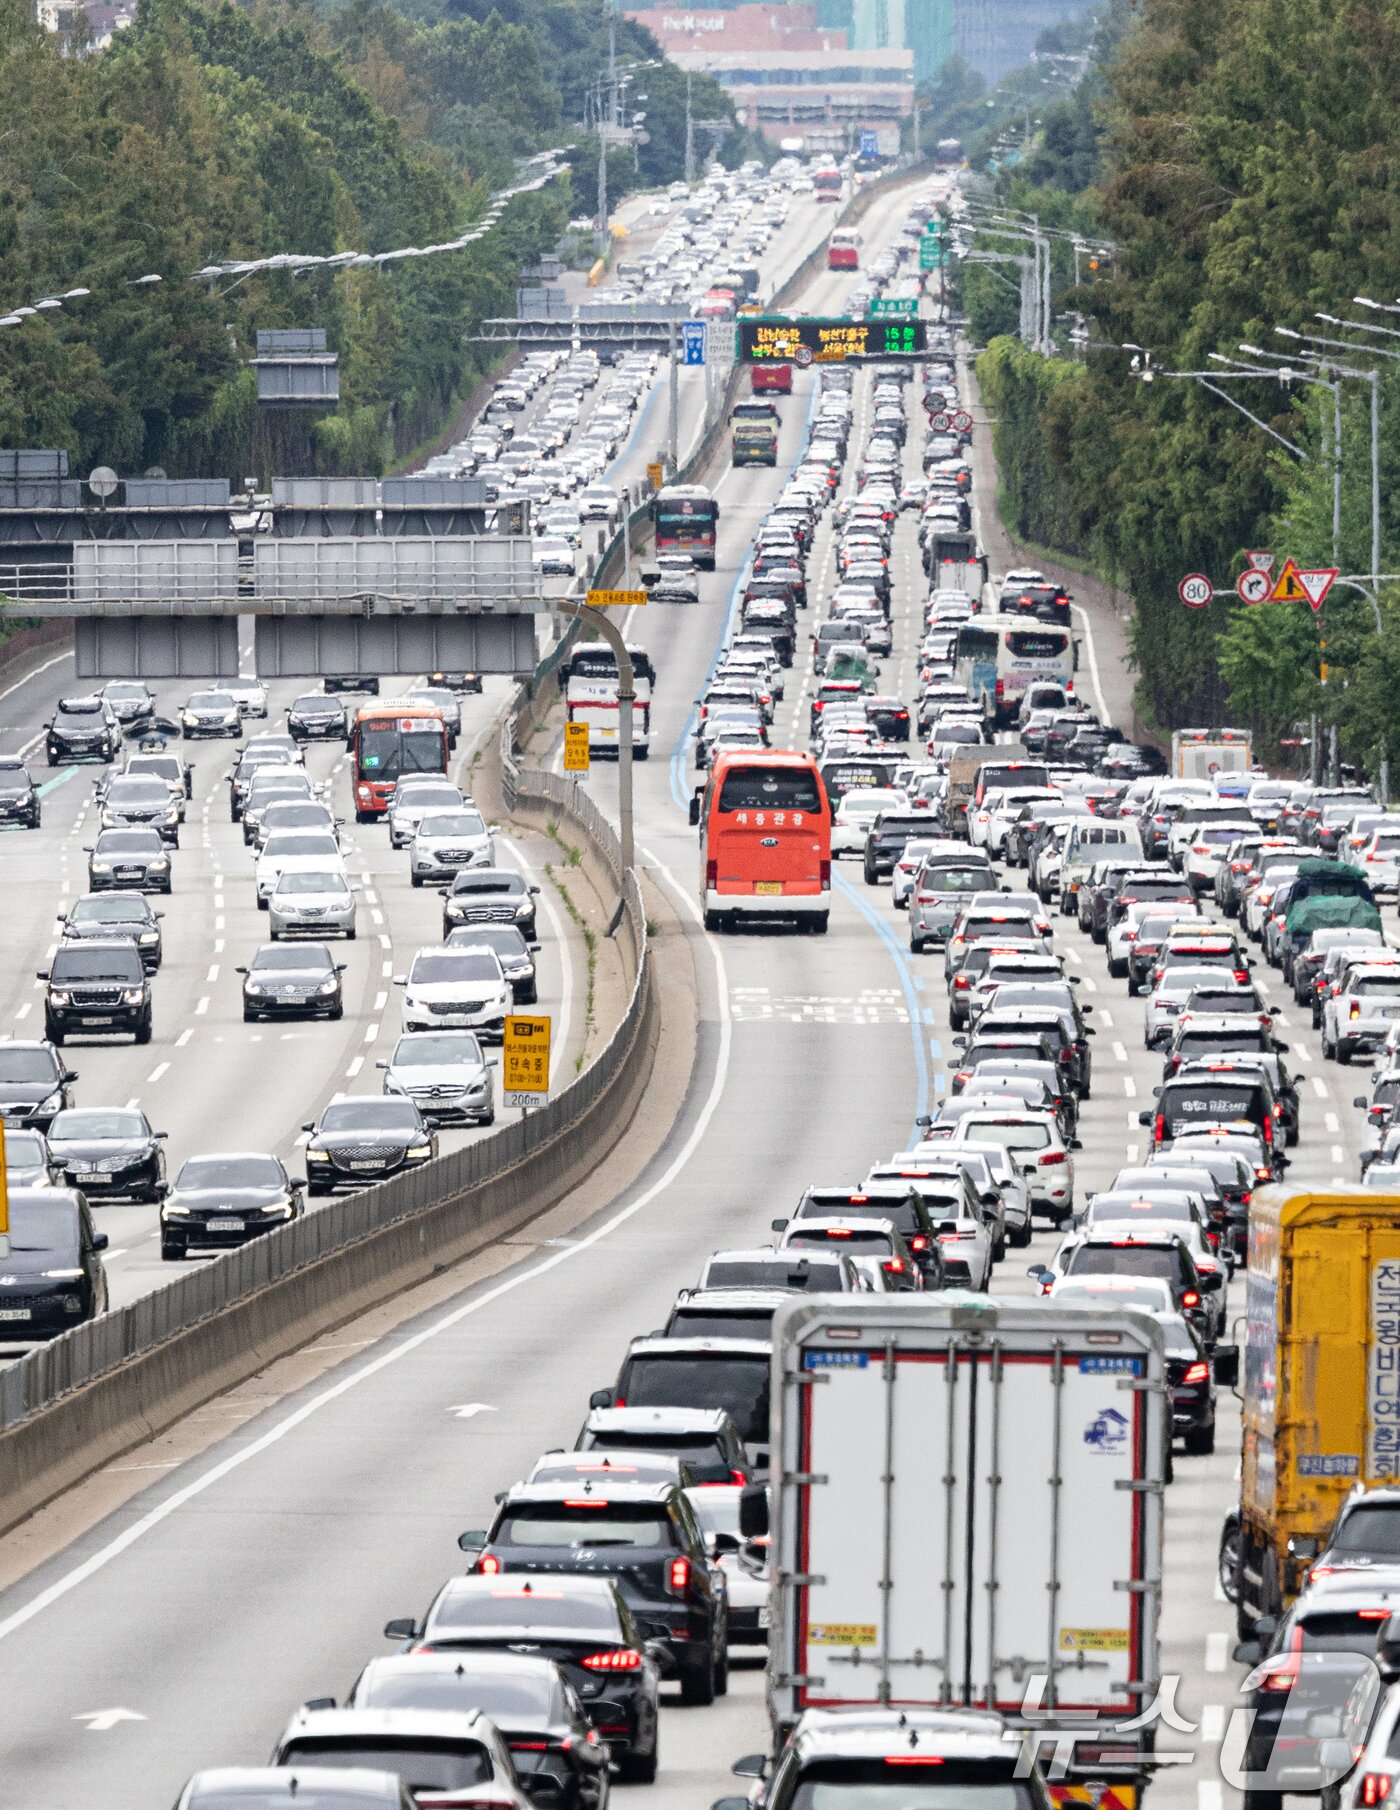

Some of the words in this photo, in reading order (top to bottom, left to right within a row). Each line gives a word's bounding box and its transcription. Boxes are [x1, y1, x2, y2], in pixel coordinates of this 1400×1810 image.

[1187, 584, 1207, 599] 80
[510, 1057, 543, 1071] 단속중
[511, 1094, 540, 1106] 200m
